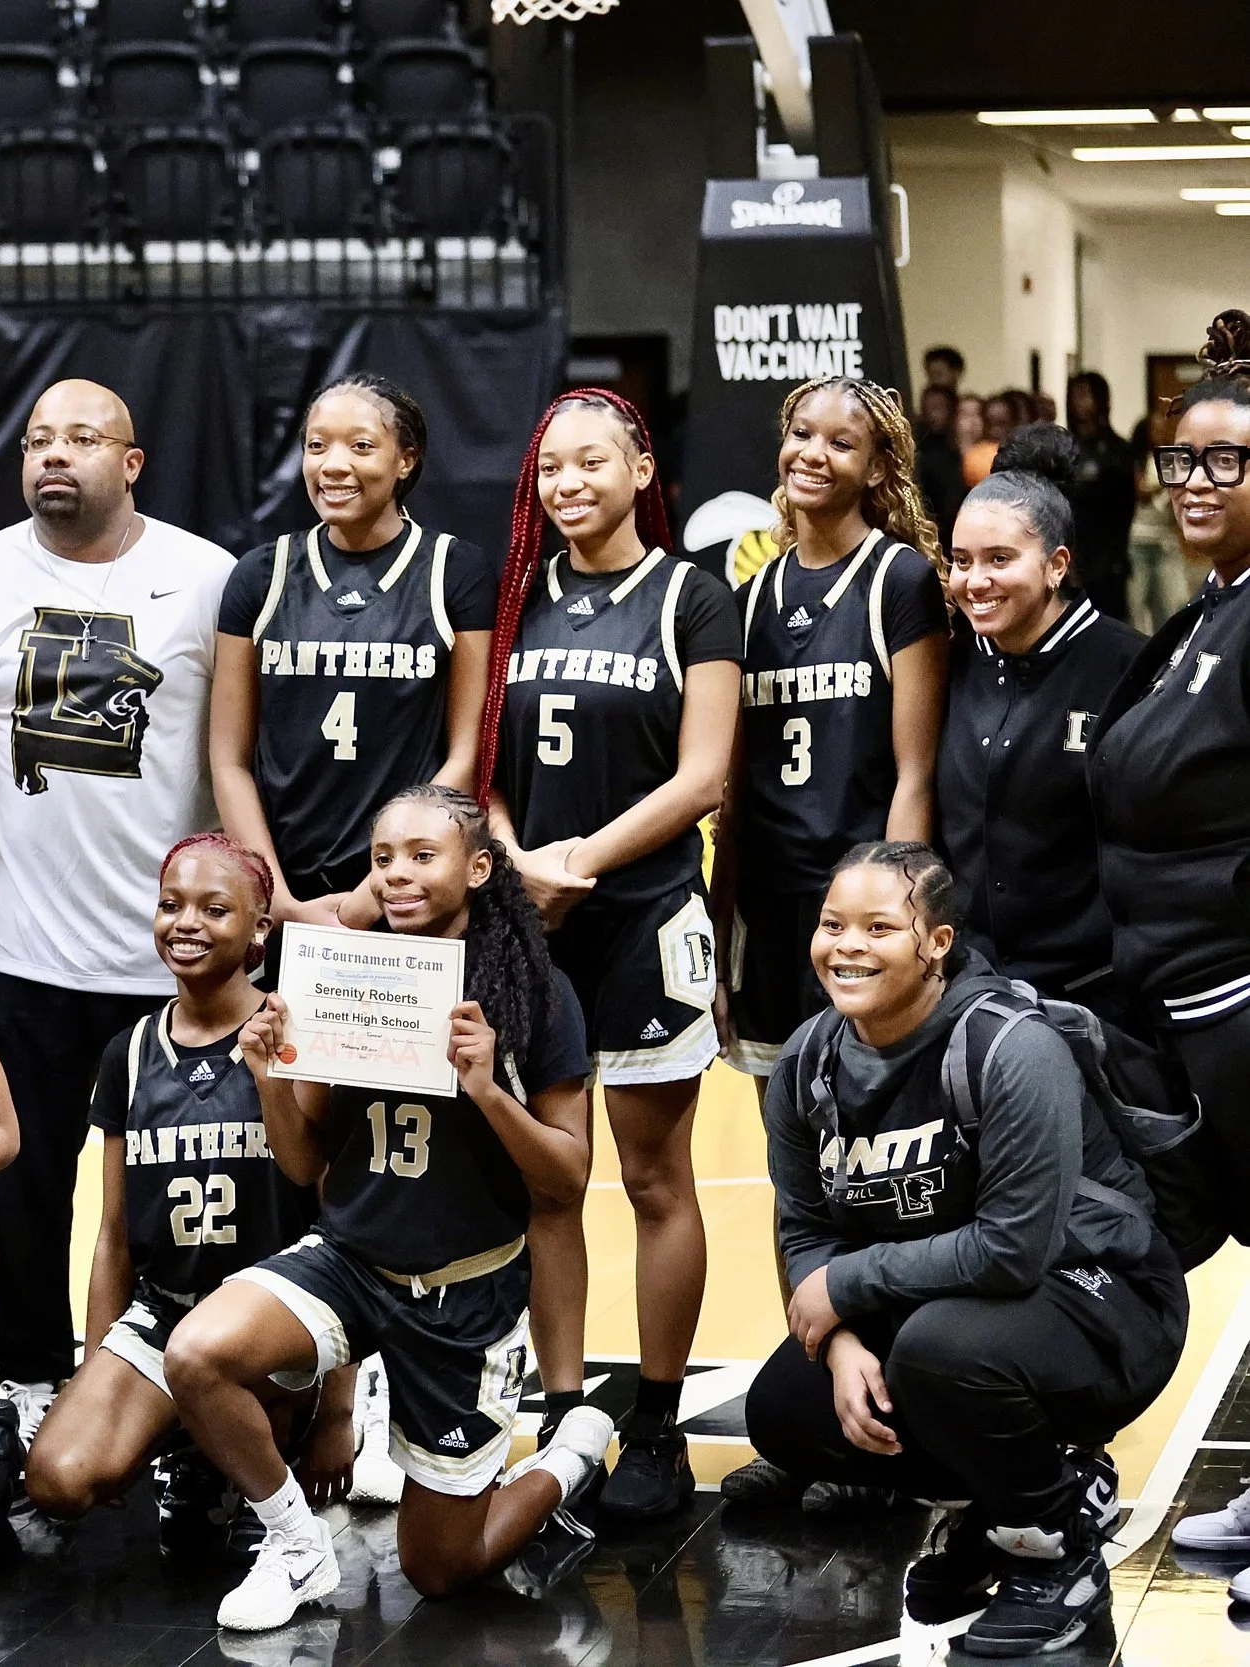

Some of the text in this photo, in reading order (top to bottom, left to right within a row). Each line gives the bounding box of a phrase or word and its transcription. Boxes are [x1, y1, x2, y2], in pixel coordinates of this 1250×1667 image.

[730, 198, 843, 229] SPALDING
[714, 302, 863, 343] DON'T WAIT
[715, 339, 864, 381] VACCINATE
[336, 597, 366, 606] adidas
[566, 607, 595, 616] adidas
[786, 618, 813, 628] adidas
[261, 638, 436, 680] PANTHERS
[506, 648, 659, 693] ANTHERS
[742, 659, 873, 708] ANTHERS
[320, 691, 358, 761] 4
[537, 694, 577, 767] 5
[780, 716, 813, 787] 3
[297, 943, 444, 972] All-Tournament Team
[314, 982, 418, 1005] Serenity Roberts
[314, 1008, 420, 1029] Lanett High School
[640, 1029, 669, 1041] adidas
[188, 1072, 216, 1082] adidas
[126, 1120, 275, 1166] PANTHER
[366, 1101, 432, 1179] 13
[166, 1174, 237, 1246] 22
[438, 1435, 470, 1449] adidas
